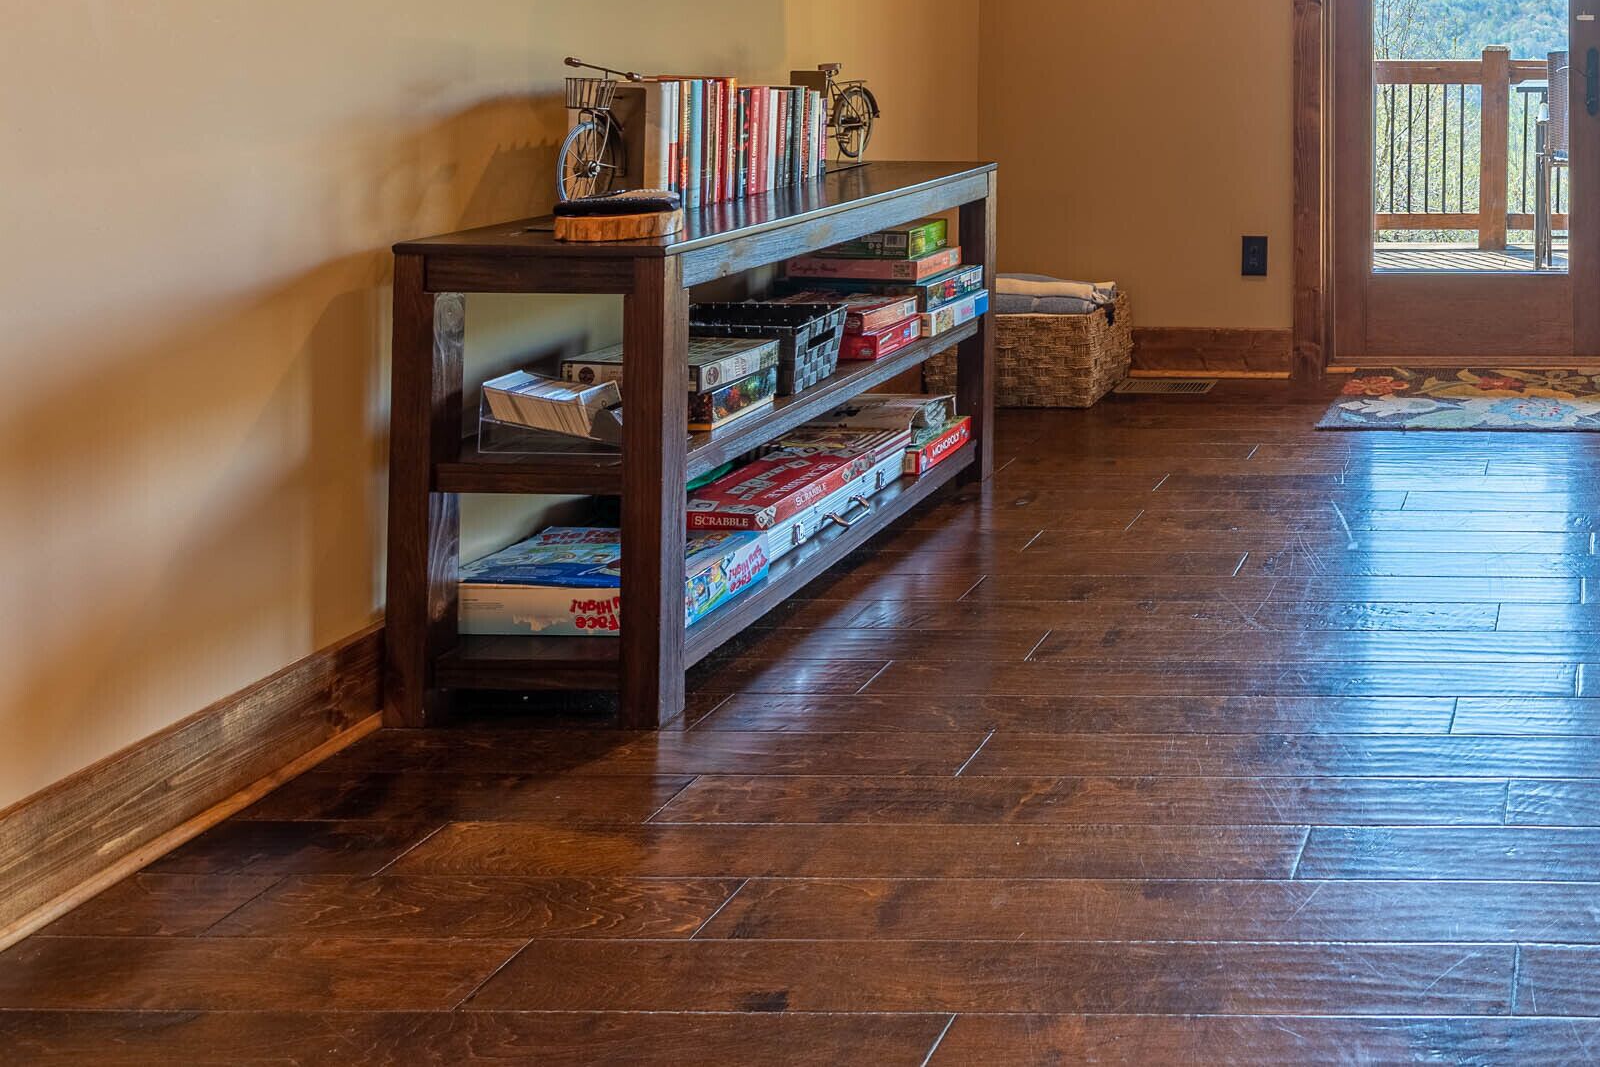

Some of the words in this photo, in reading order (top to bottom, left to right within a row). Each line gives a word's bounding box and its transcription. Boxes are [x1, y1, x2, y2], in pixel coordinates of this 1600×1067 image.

[932, 431, 960, 458] MONOPOLY
[795, 483, 827, 506] SCRABBLE
[694, 516, 749, 527] SCRABBLE
[569, 599, 612, 615] High!
[575, 614, 619, 631] Face
